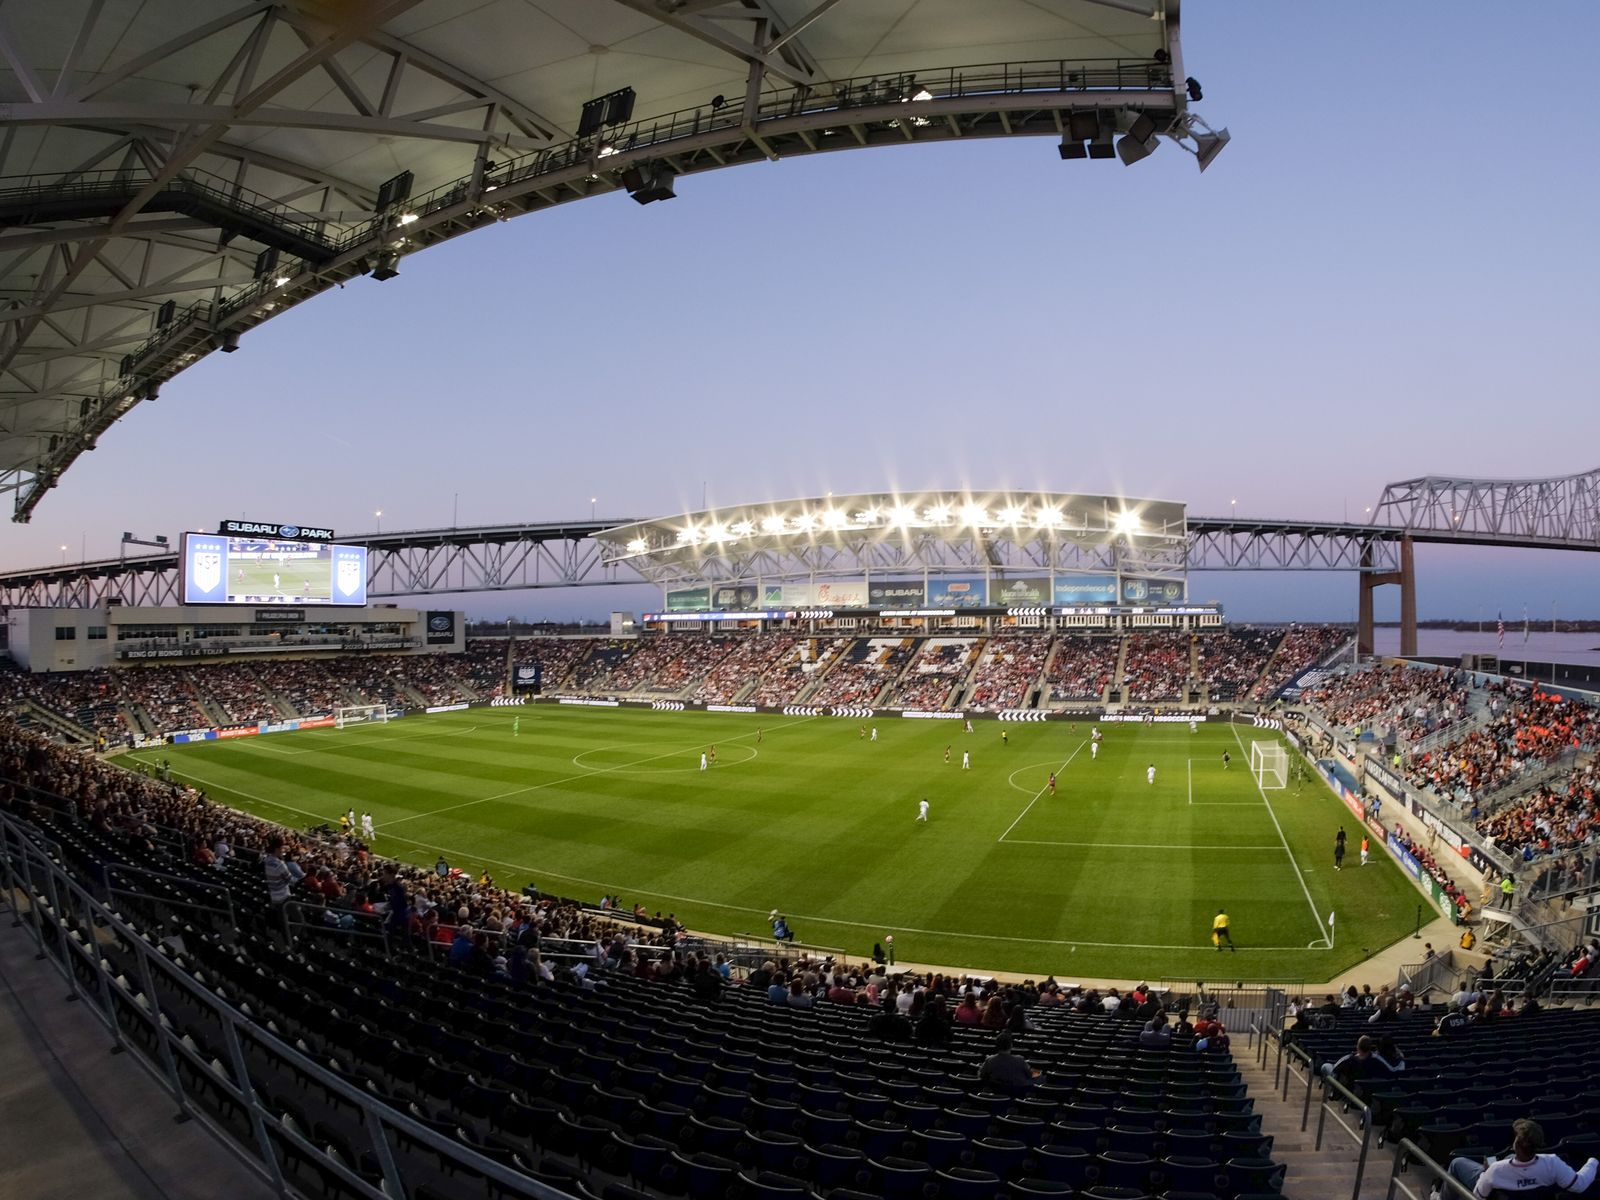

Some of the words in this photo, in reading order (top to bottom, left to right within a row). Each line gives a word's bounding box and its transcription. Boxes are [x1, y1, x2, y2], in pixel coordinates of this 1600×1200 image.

[227, 521, 277, 534] SUBARU
[301, 529, 332, 539] PARK
[884, 588, 923, 596] SUBARU
[1055, 584, 1108, 594] Independence
[188, 733, 206, 742] VISA
